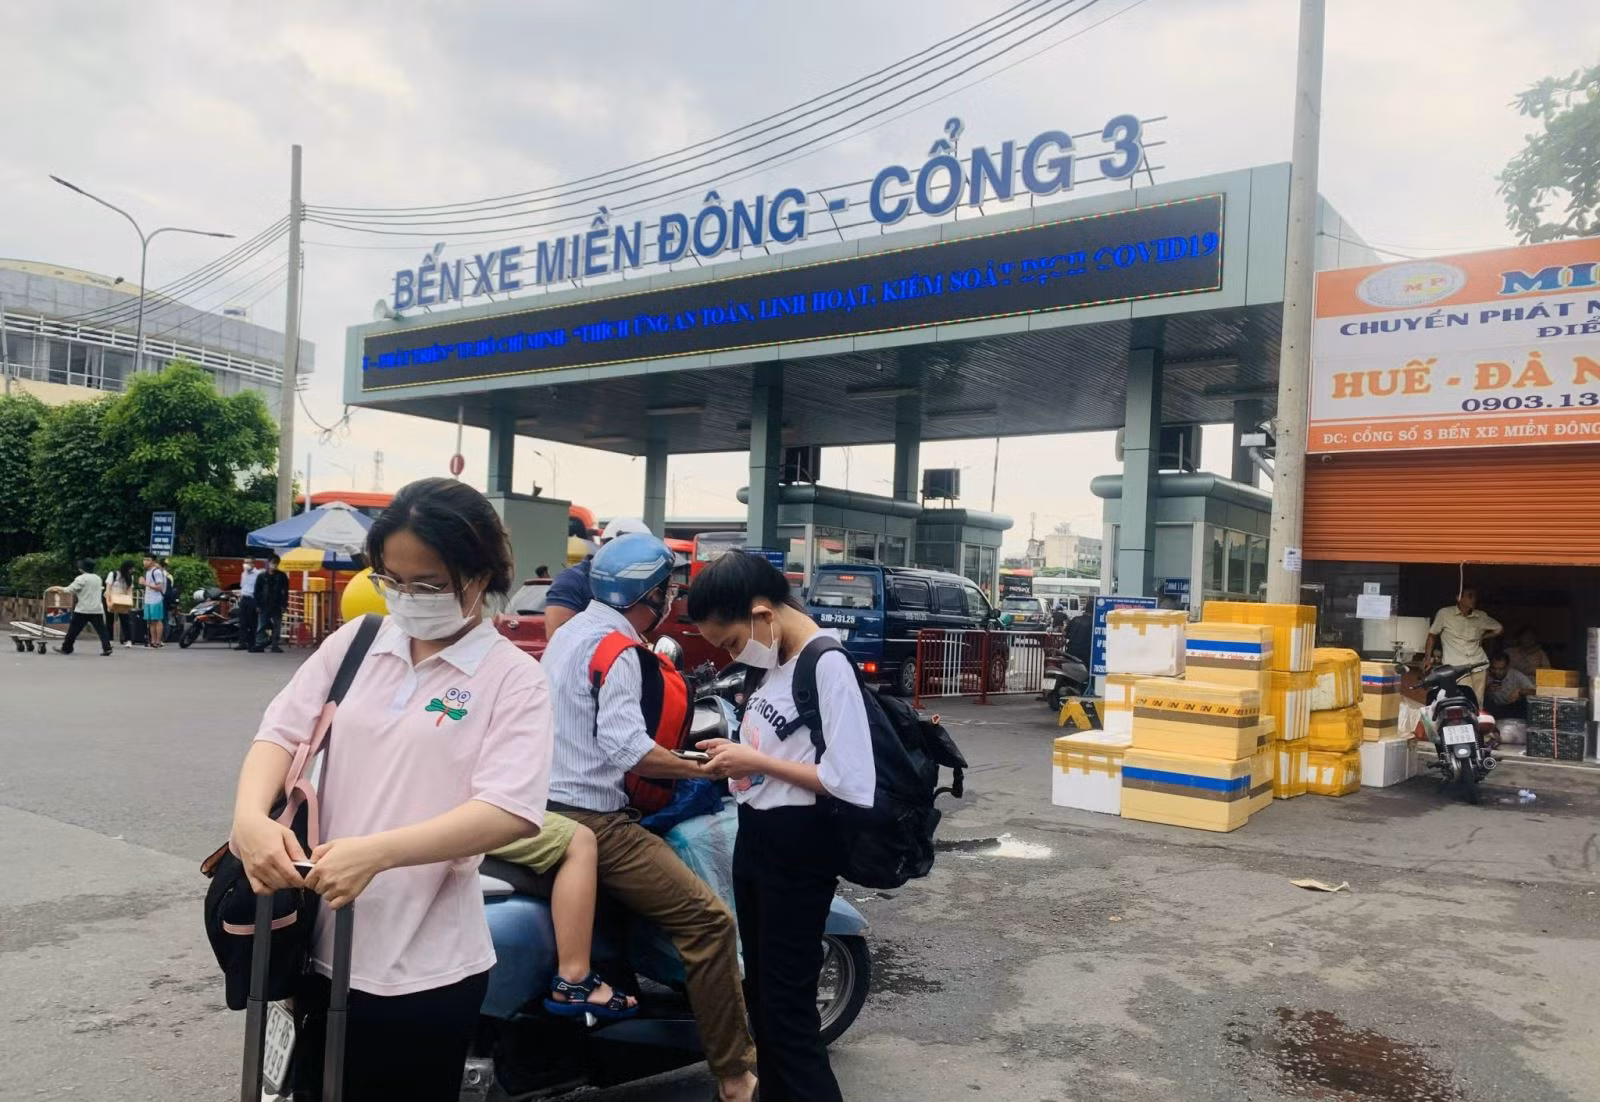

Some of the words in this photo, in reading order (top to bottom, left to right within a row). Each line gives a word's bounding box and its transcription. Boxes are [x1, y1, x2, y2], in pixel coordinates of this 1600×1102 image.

[392, 241, 464, 312] BẾN
[472, 244, 526, 297] XE
[535, 205, 646, 286] MIỀN
[658, 188, 808, 264] ĐÔNG
[869, 116, 1076, 226] CỔNG
[1099, 114, 1145, 181] 3
[672, 310, 697, 331] AN
[758, 293, 807, 319] LINH
[1094, 231, 1219, 271] COVID19
[1479, 302, 1576, 324] PHÁT
[1331, 357, 1438, 400] HUẾ
[1474, 351, 1553, 391] ĐÀ
[1461, 392, 1599, 412] 0903.13
[1323, 432, 1348, 444] ĐC:
[1353, 425, 1393, 443] CỔNG
[1398, 424, 1418, 441] SỐ
[1424, 429, 1432, 440] 3
[1438, 422, 1470, 439] BẾN
[1476, 426, 1499, 438] XE
[1504, 418, 1548, 437] MIỀN
[1554, 420, 1600, 436] ĐÔNG
